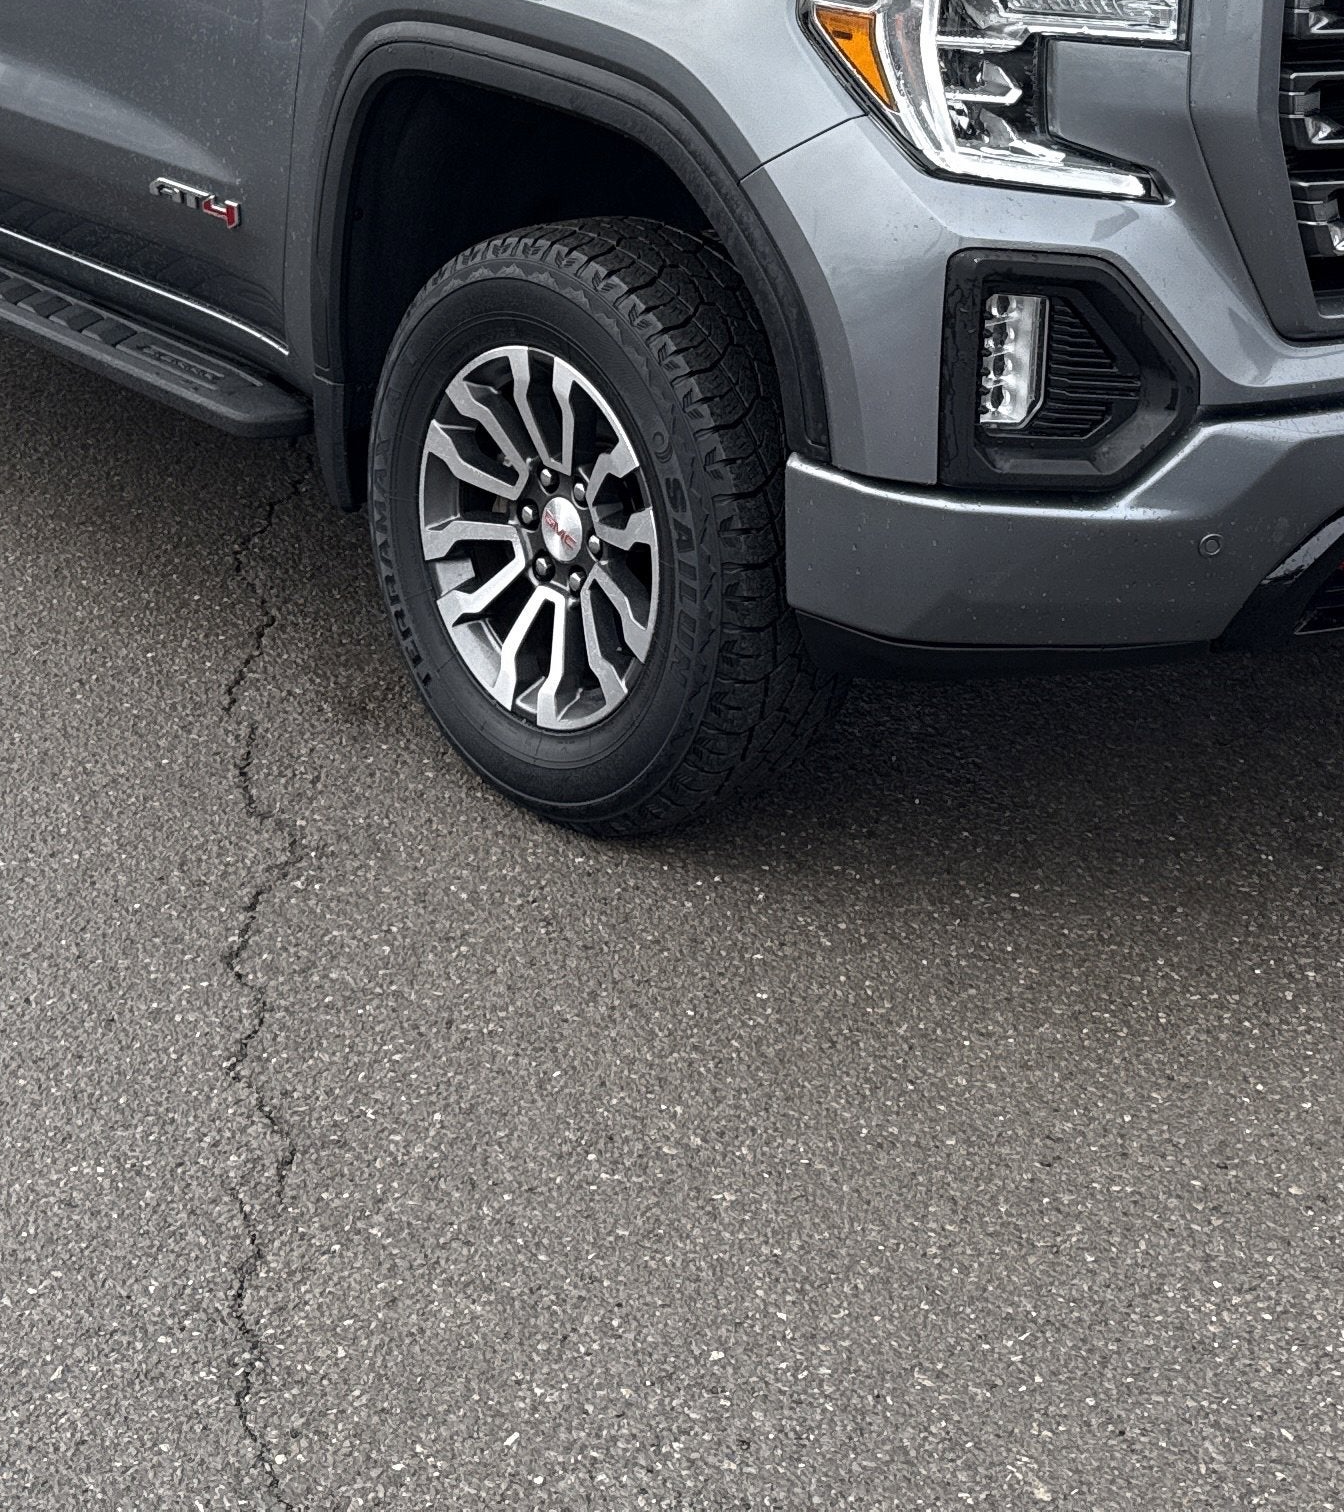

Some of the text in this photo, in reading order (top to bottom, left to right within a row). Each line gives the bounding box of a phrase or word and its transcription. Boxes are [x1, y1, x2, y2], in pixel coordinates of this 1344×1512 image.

[149, 176, 241, 229] AT4
[544, 508, 578, 551] GMC
[663, 476, 698, 687] SAILUN
